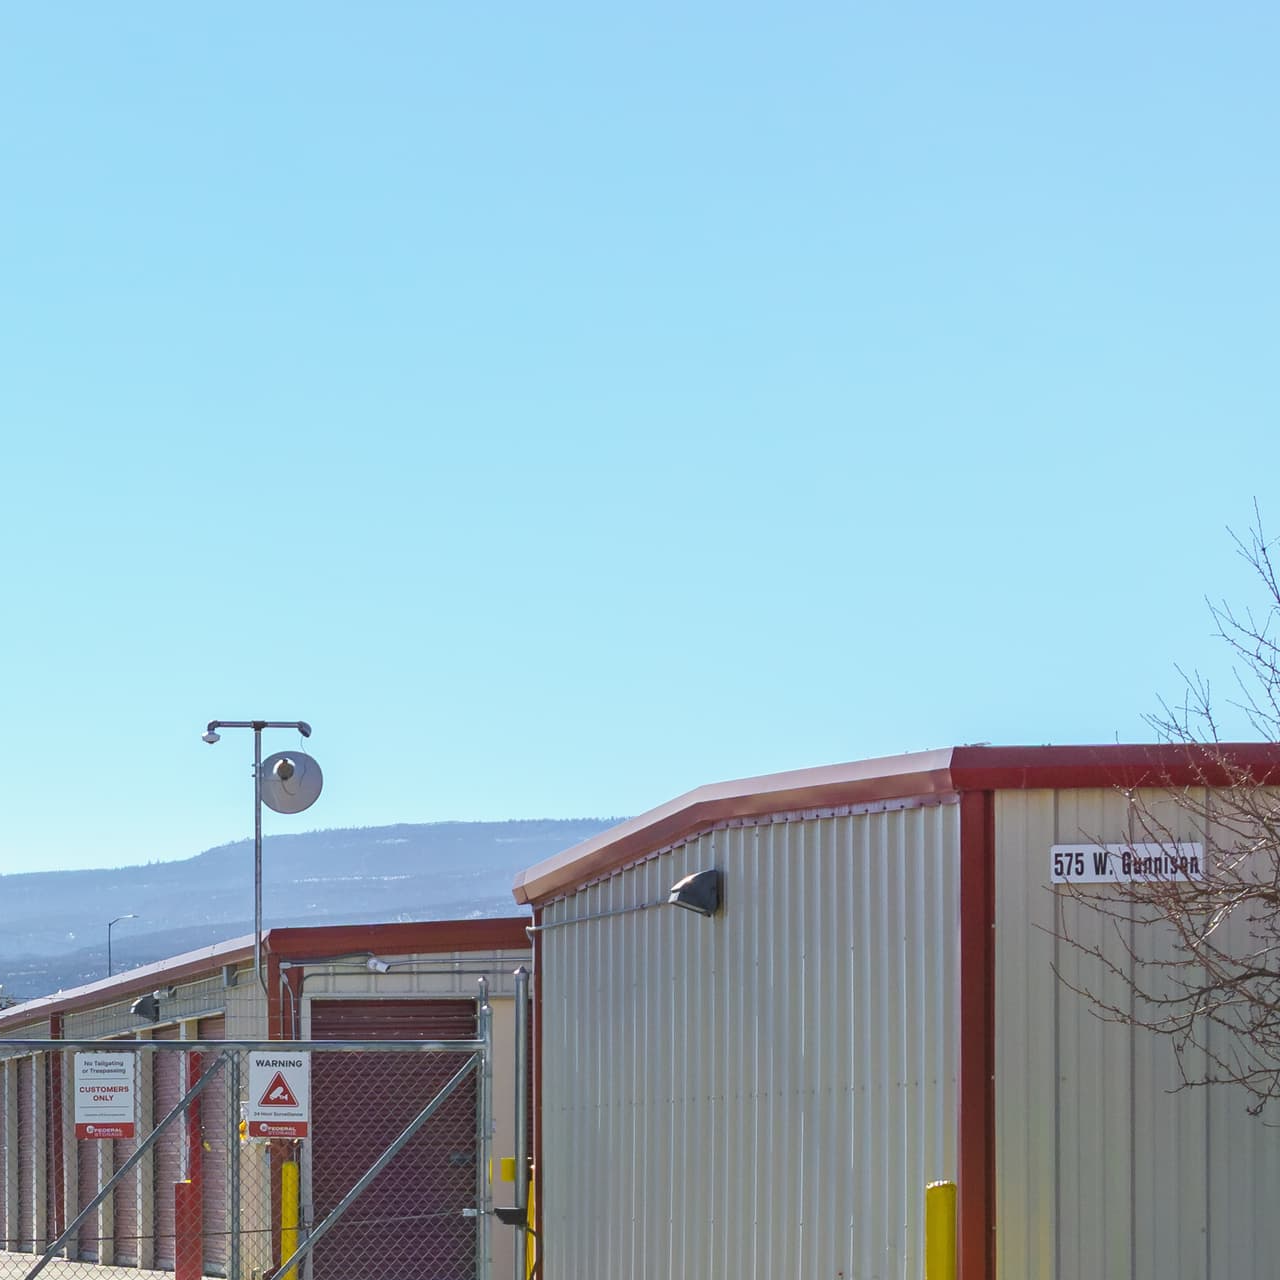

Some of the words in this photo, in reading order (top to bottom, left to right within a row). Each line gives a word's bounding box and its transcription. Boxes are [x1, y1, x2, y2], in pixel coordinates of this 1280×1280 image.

[1054, 852, 1084, 876] 575
[1093, 852, 1113, 876] W.
[1121, 851, 1199, 876] Gunnison
[95, 1060, 124, 1068] Tailgating
[255, 1059, 303, 1068] WARNING
[79, 1085, 129, 1093] CUSTOMERS
[93, 1094, 114, 1102] ONLY
